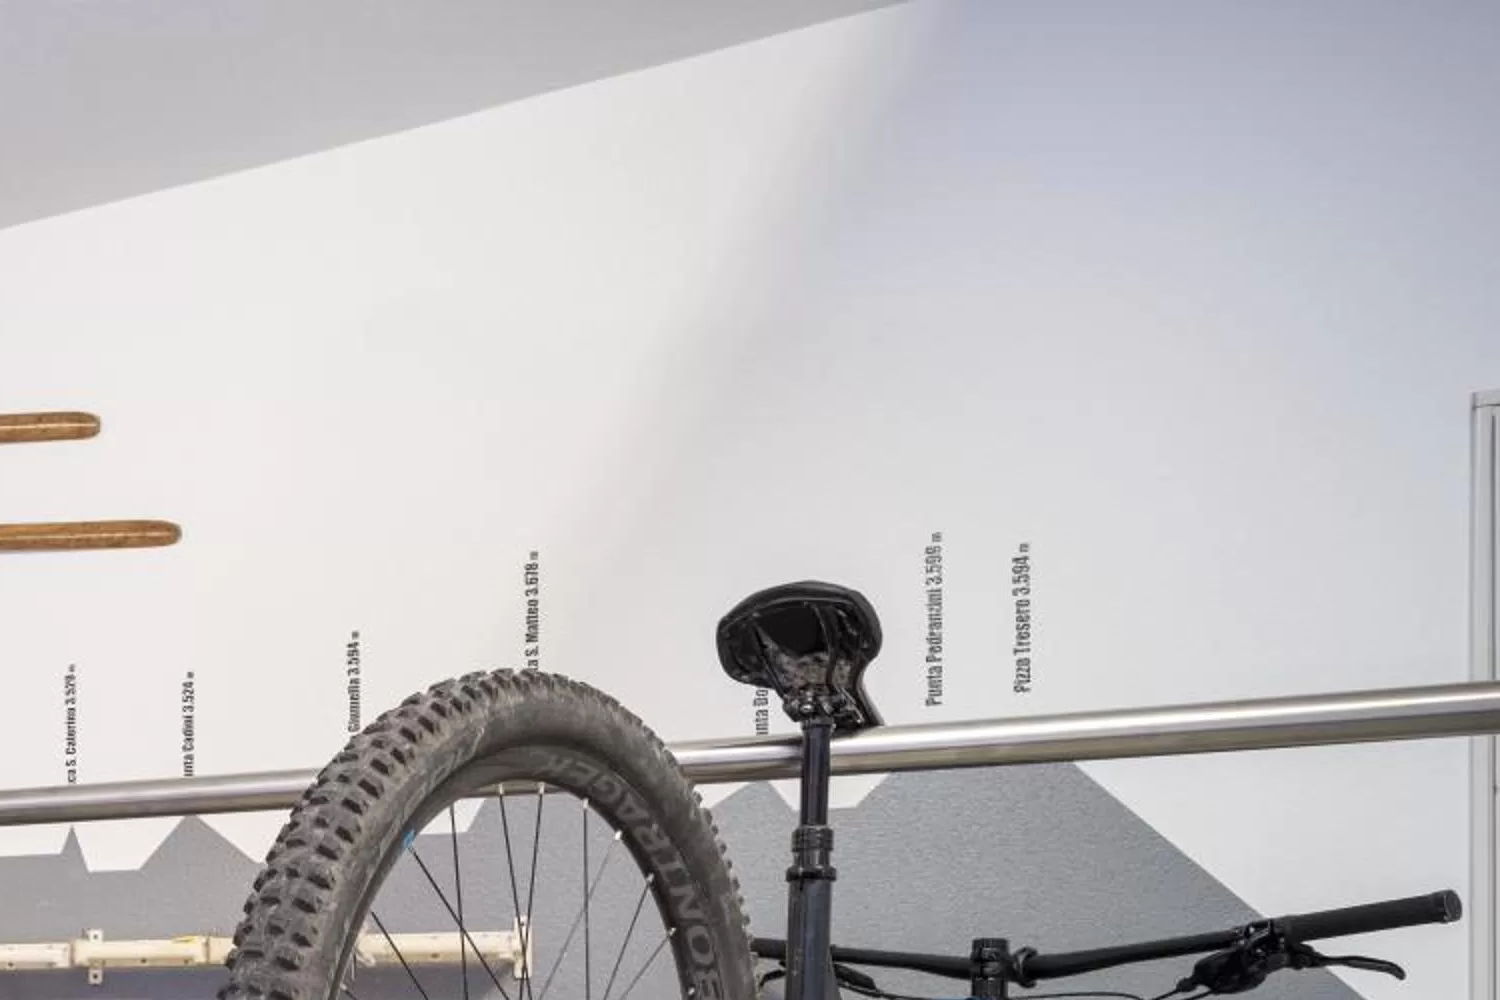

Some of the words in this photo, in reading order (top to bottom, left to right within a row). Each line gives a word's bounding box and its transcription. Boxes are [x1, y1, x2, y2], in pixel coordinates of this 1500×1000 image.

[1011, 555, 1031, 597] 3.594
[524, 599, 539, 644] Matteo
[924, 588, 943, 663] Pedranzini
[1012, 598, 1031, 656] Tresero
[924, 664, 943, 707] Punta
[1012, 657, 1031, 694] Pizzo
